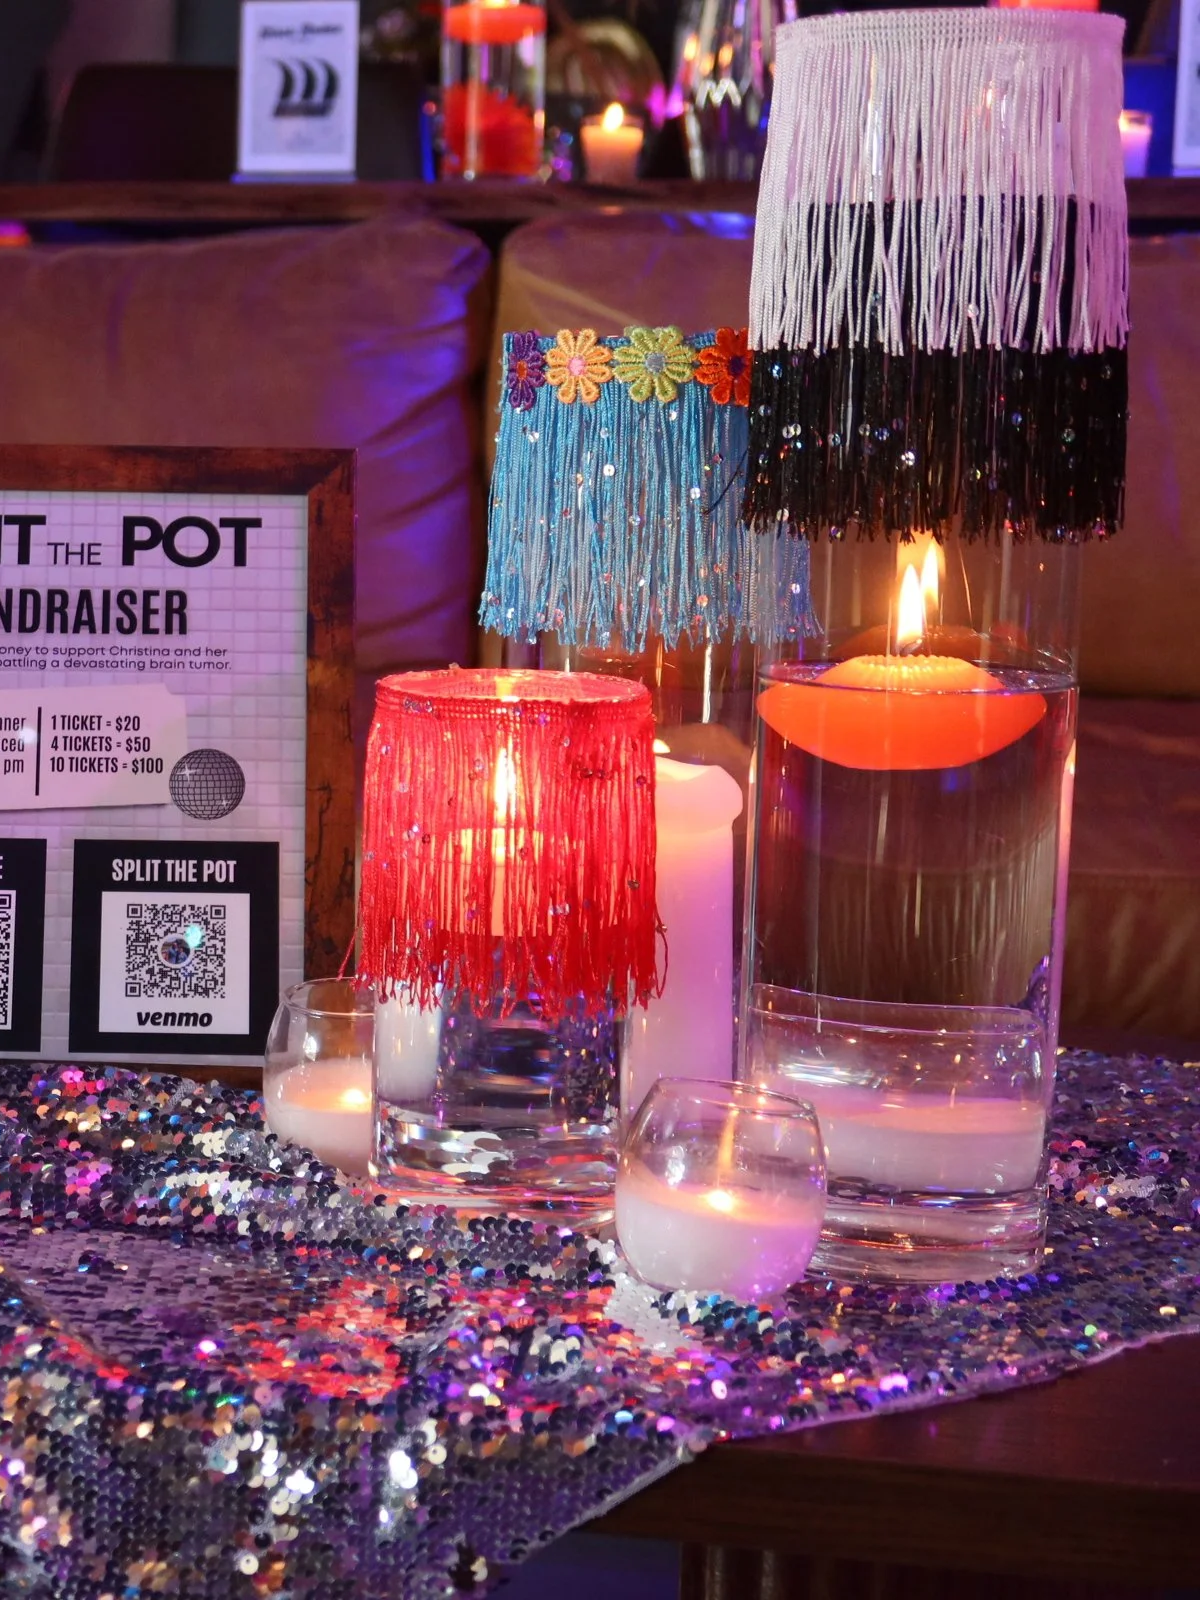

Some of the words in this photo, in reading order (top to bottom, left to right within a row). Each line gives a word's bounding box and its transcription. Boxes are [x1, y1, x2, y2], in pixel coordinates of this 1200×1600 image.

[47, 542, 102, 566] THE
[122, 515, 262, 567] POT
[35, 646, 49, 655] to
[52, 646, 106, 657] support
[109, 645, 171, 656] Christina
[174, 646, 202, 656] and
[205, 646, 228, 657] her
[50, 658, 60, 668] a
[63, 658, 146, 671] devastating
[149, 658, 186, 669] brain
[189, 659, 232, 670] tumor.
[51, 715, 57, 731] 1
[60, 715, 103, 731] TICKET
[115, 715, 141, 732] $20
[51, 736, 59, 751] 4
[62, 735, 112, 752] TICKETS
[125, 736, 151, 754] $50
[3, 760, 25, 775] pm
[50, 757, 65, 773] 10
[68, 756, 119, 773] TICKETS
[131, 757, 164, 775] $100
[111, 858, 162, 882] SPLIT
[164, 859, 198, 883] THE
[202, 860, 237, 883] POT
[136, 1011, 213, 1028] venmo
